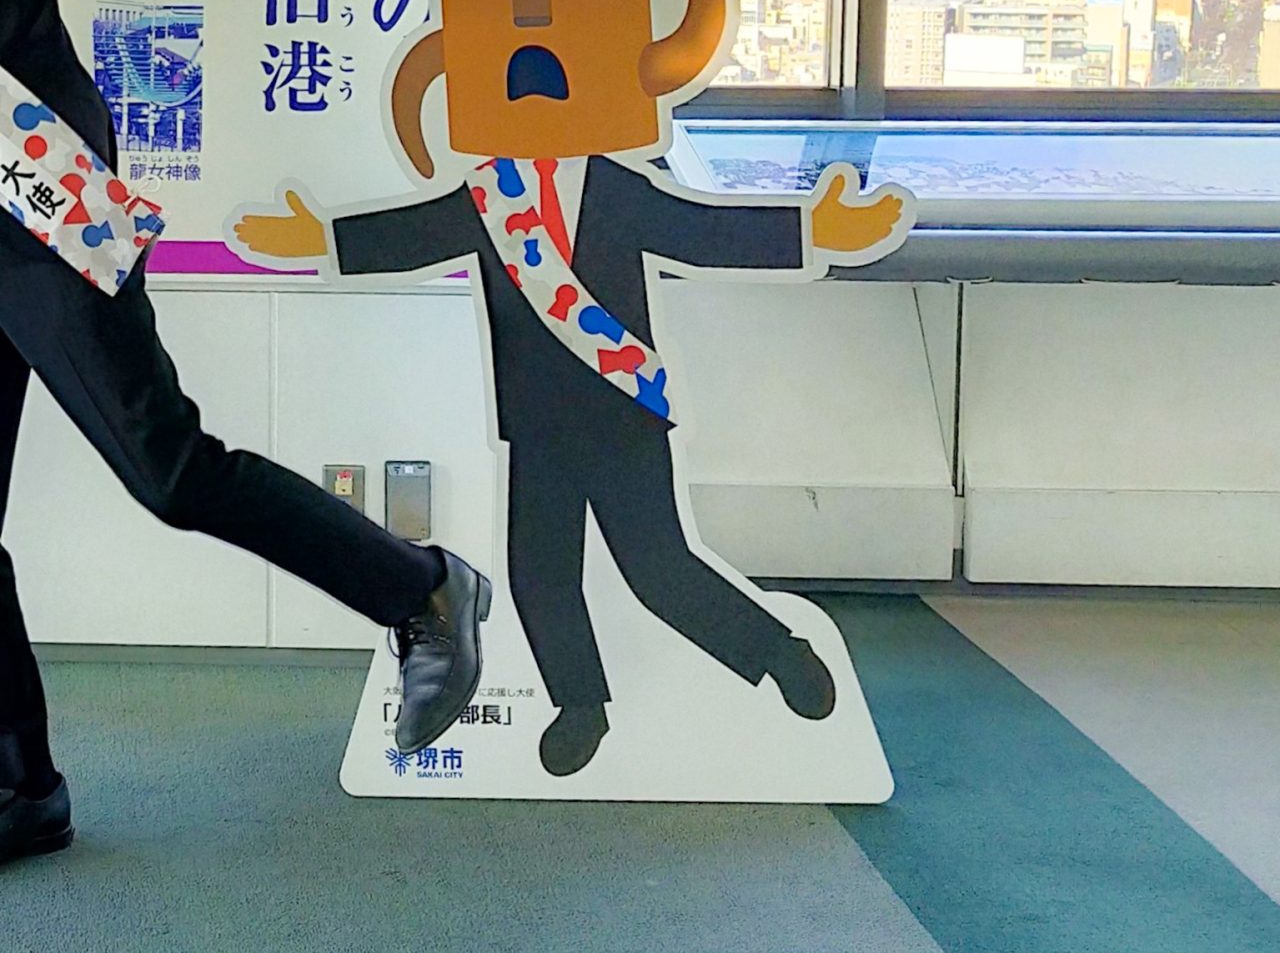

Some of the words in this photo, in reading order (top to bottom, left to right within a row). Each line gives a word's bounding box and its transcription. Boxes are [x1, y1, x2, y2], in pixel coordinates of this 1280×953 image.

[129, 163, 201, 181] 龍女神像
[417, 748, 463, 770] 堺市
